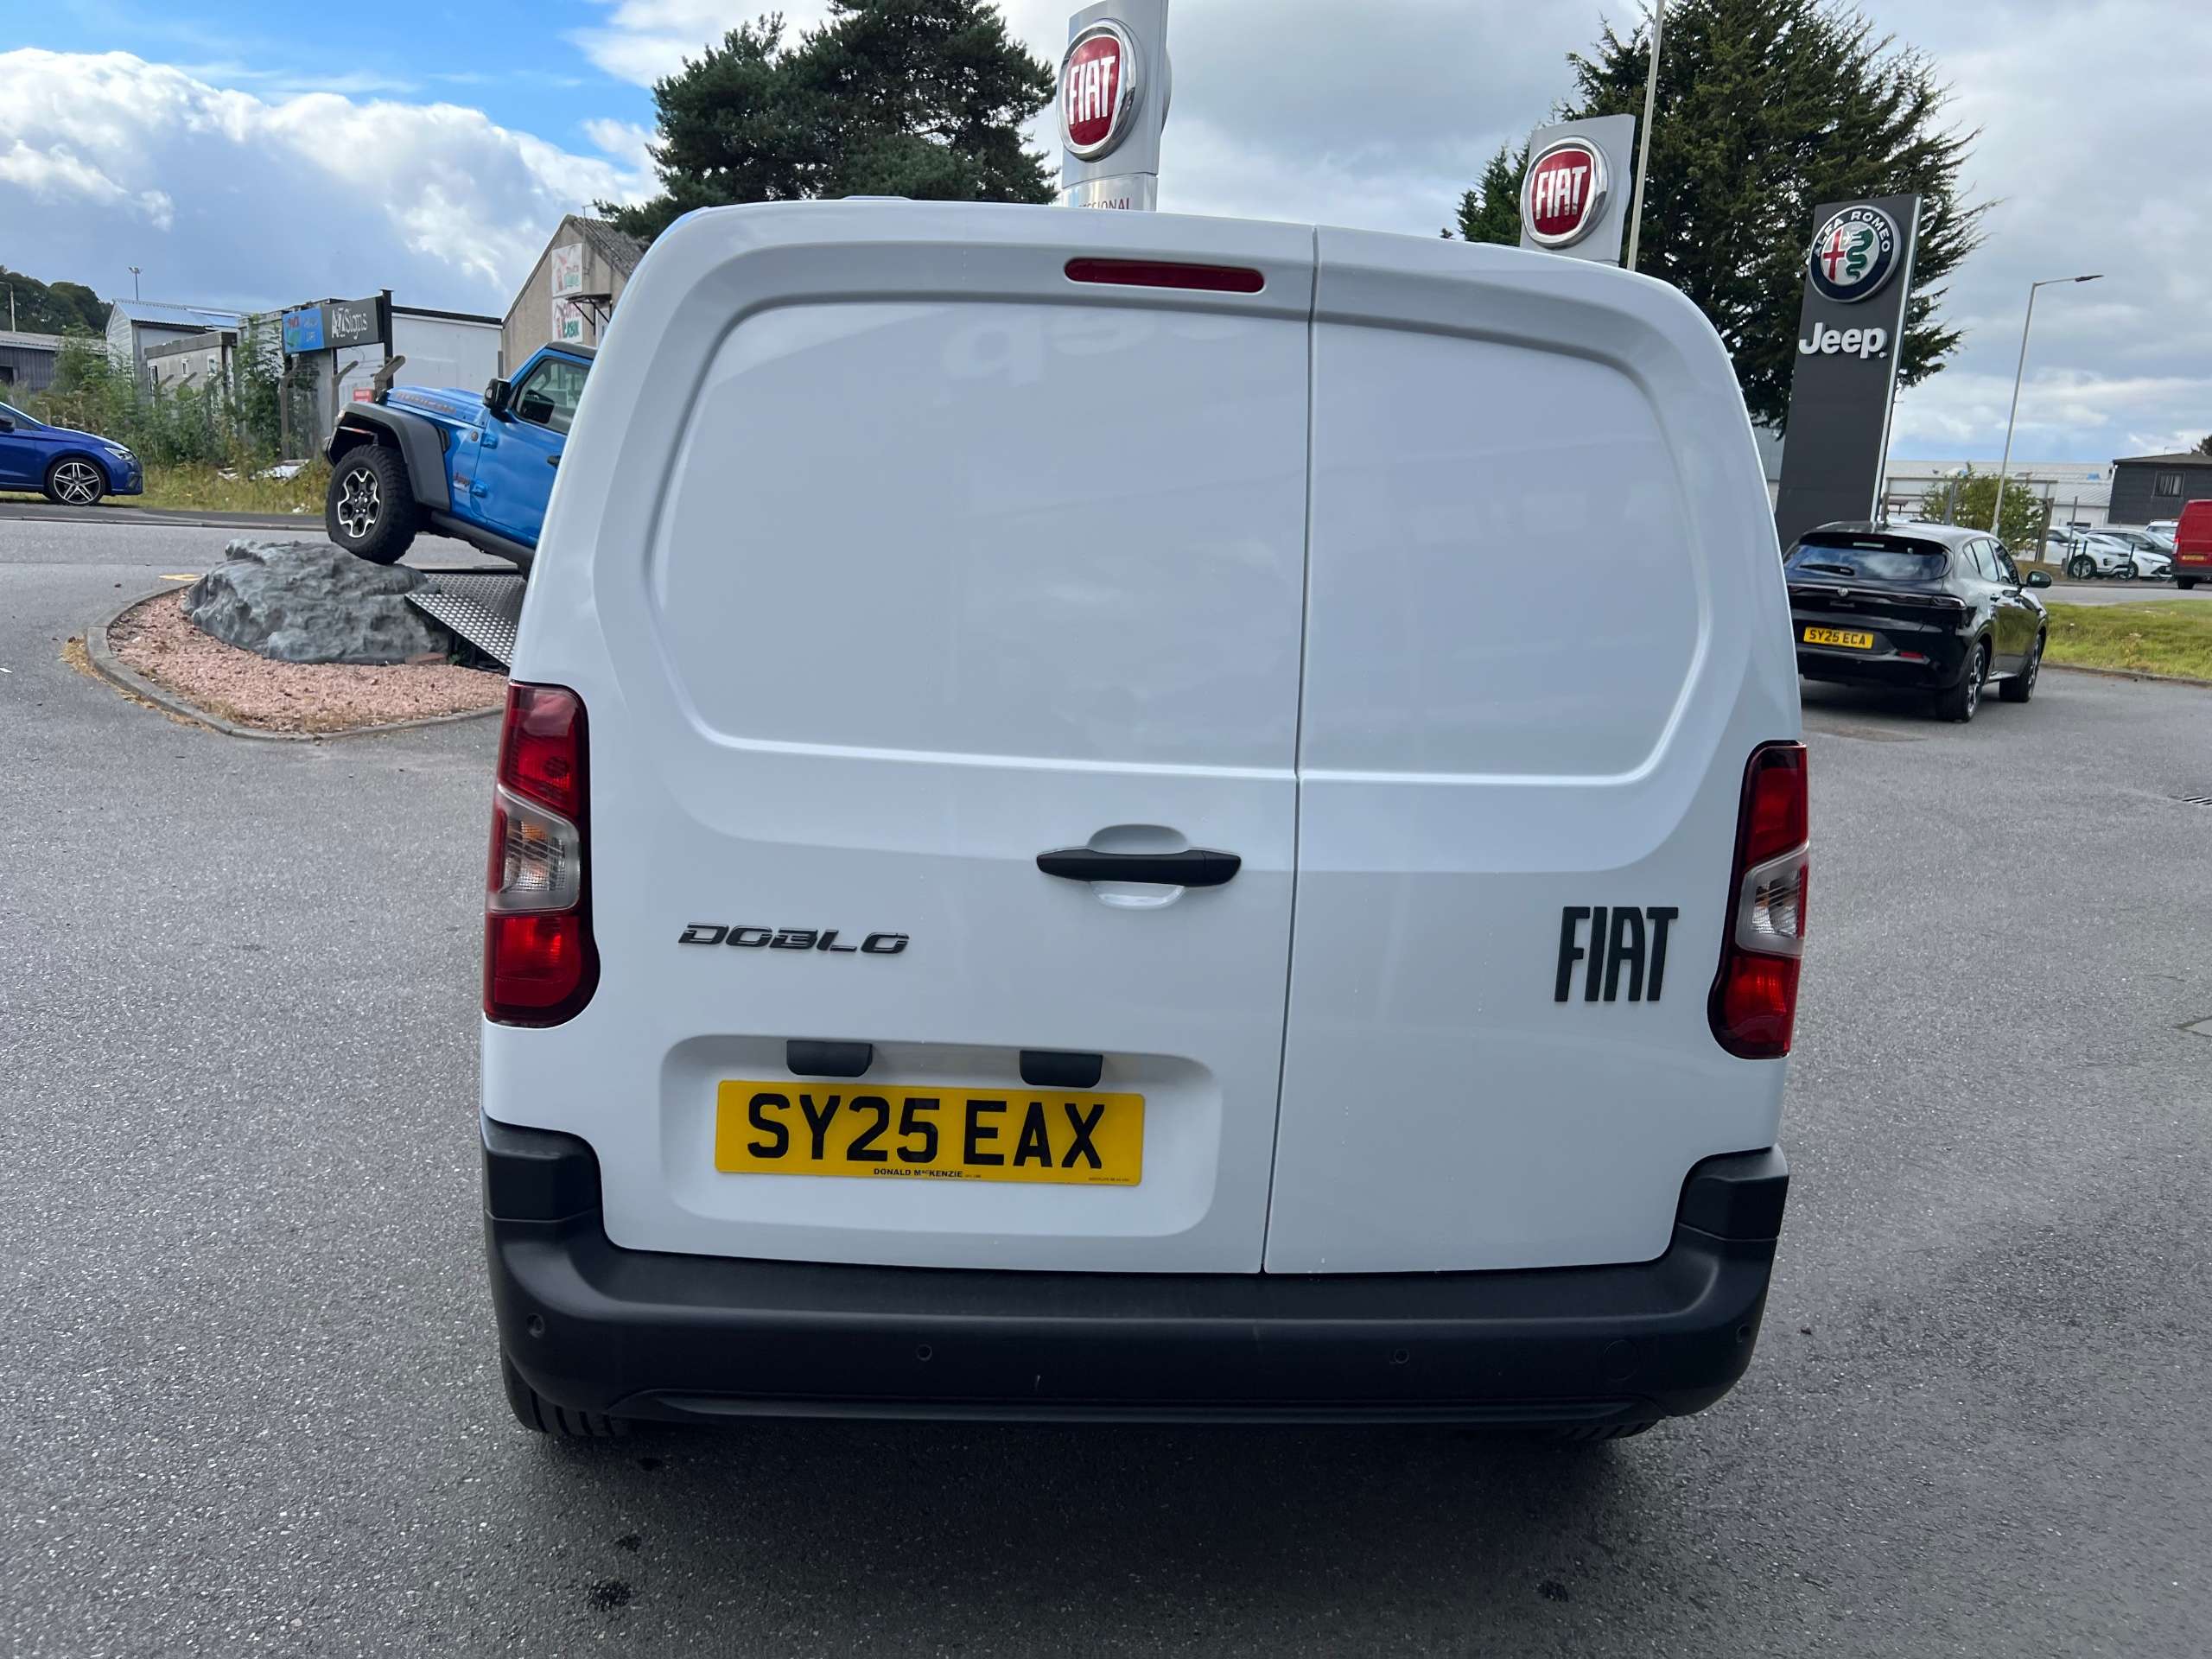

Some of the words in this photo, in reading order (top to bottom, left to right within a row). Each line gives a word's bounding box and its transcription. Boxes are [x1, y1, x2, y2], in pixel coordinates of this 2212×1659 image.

[1069, 55, 1116, 125] FIAT
[1535, 166, 1587, 220] FIAT
[1814, 218, 1844, 257] ALFA
[1851, 211, 1891, 252] ROMEO
[1809, 628, 1840, 644] SY25
[1842, 632, 1866, 646] ECA
[678, 921, 910, 955] DOBLO
[1554, 906, 1679, 1002] FIAT
[747, 1092, 940, 1164] SY25
[963, 1099, 1105, 1169] EAX
[874, 1167, 911, 1176] DONALD
